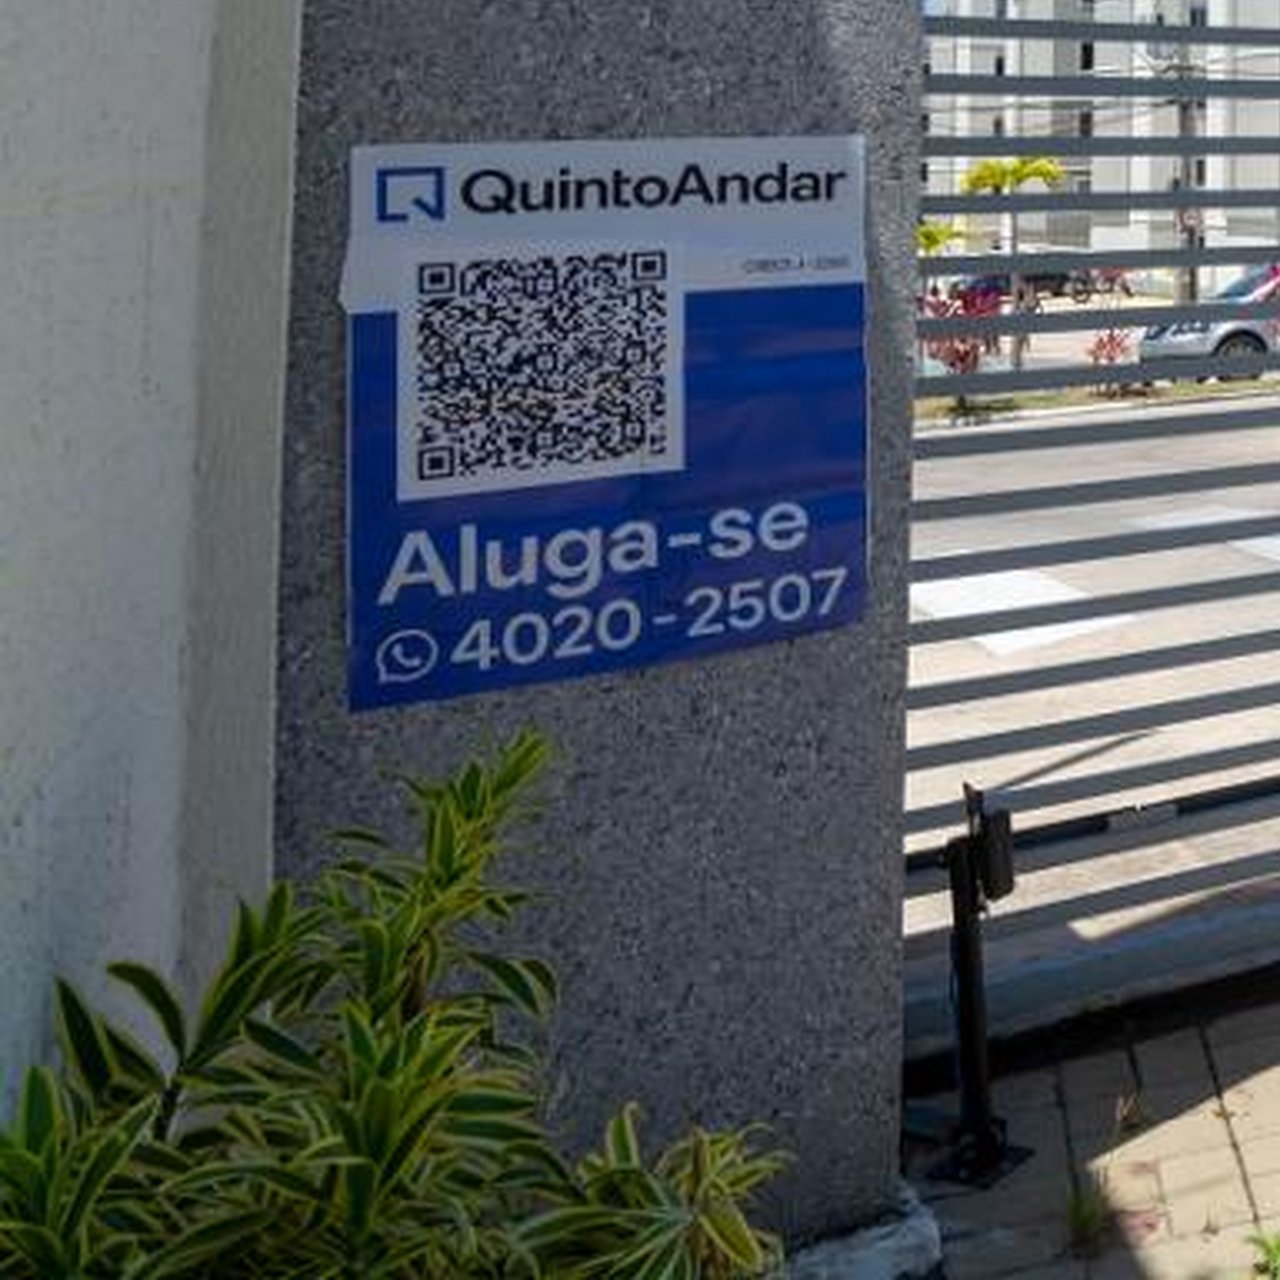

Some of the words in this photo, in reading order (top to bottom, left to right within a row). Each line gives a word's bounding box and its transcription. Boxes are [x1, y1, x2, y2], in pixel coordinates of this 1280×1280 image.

[461, 163, 846, 215] QuintoAndar
[377, 501, 809, 606] Aluga-se
[450, 567, 849, 671] 4020-2507
